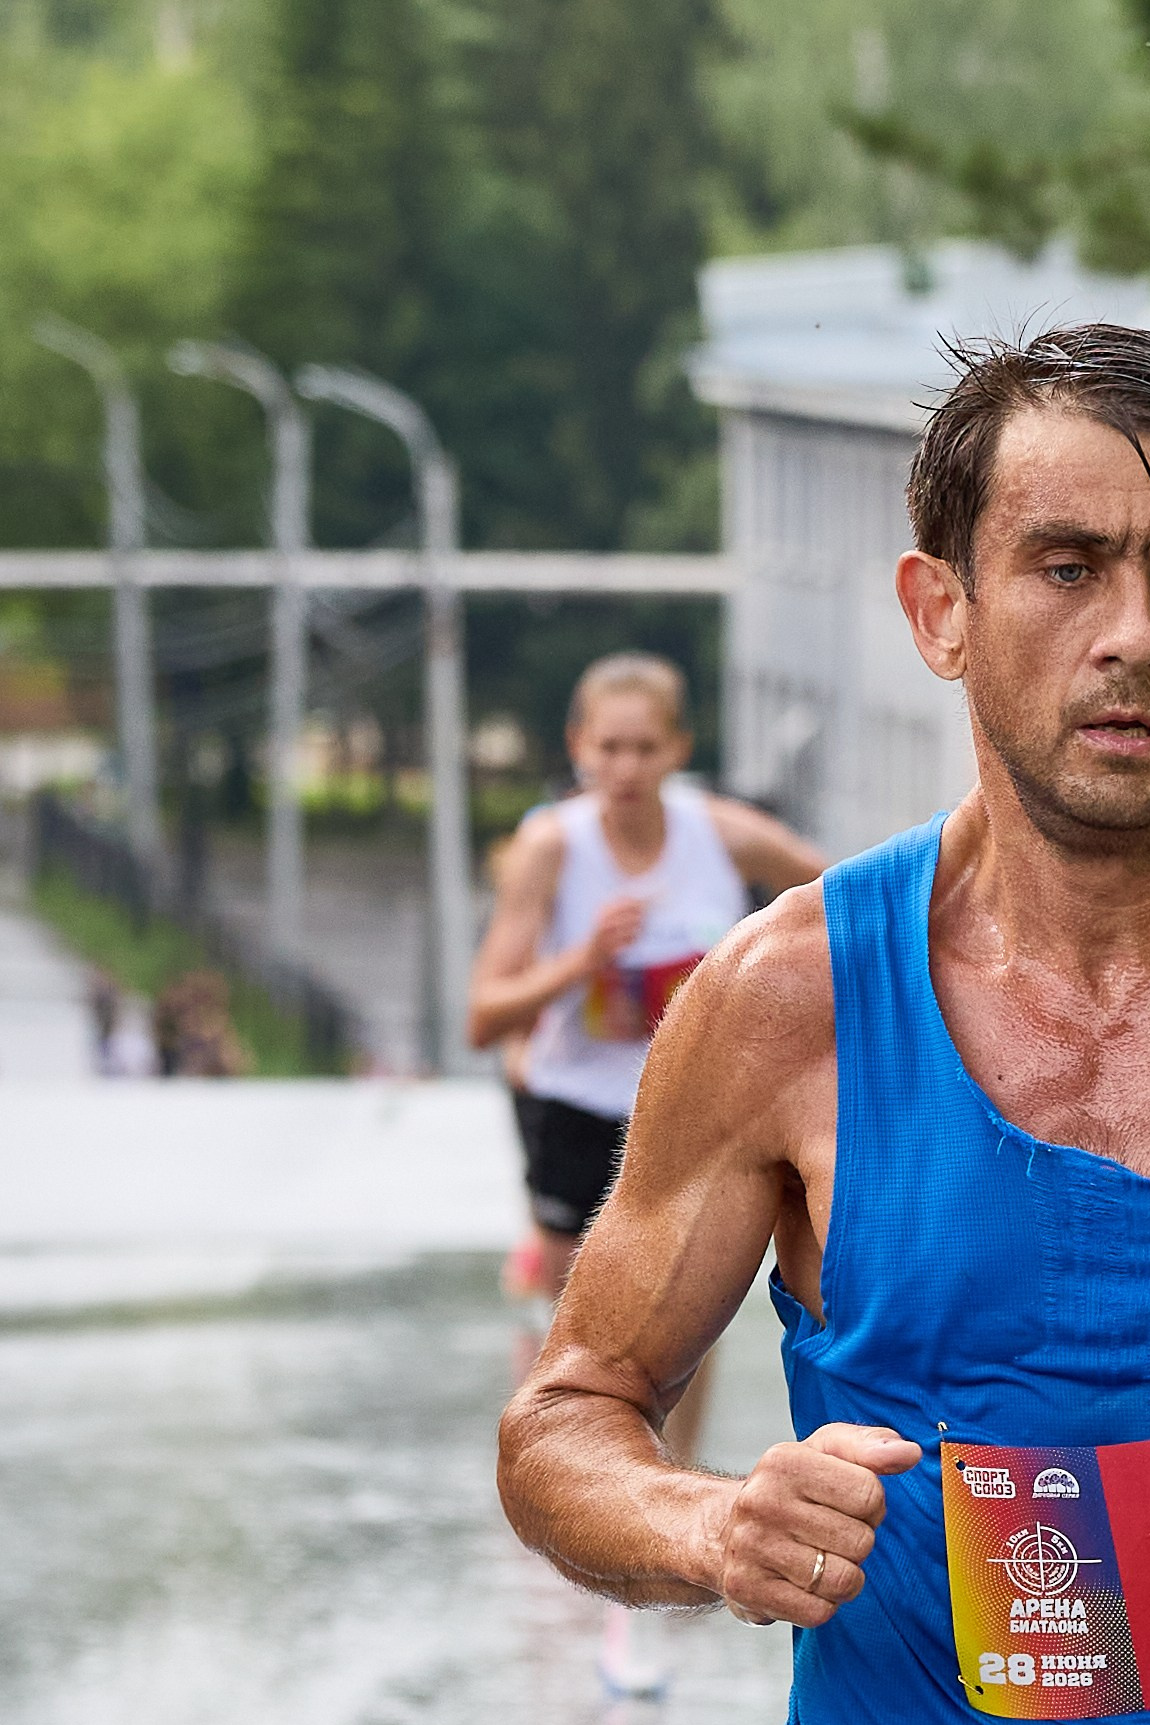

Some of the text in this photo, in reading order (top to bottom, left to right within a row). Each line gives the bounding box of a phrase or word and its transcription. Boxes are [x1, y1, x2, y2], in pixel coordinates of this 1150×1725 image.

[966, 1470, 1005, 1482] СПОРТ
[975, 1483, 1012, 1495] СОЮЗ
[1010, 1599, 1087, 1619] АРЕНА
[1010, 1620, 1089, 1634] БИАТЛОНА
[979, 1652, 1036, 1686] 28
[1042, 1672, 1094, 1687] 2026
